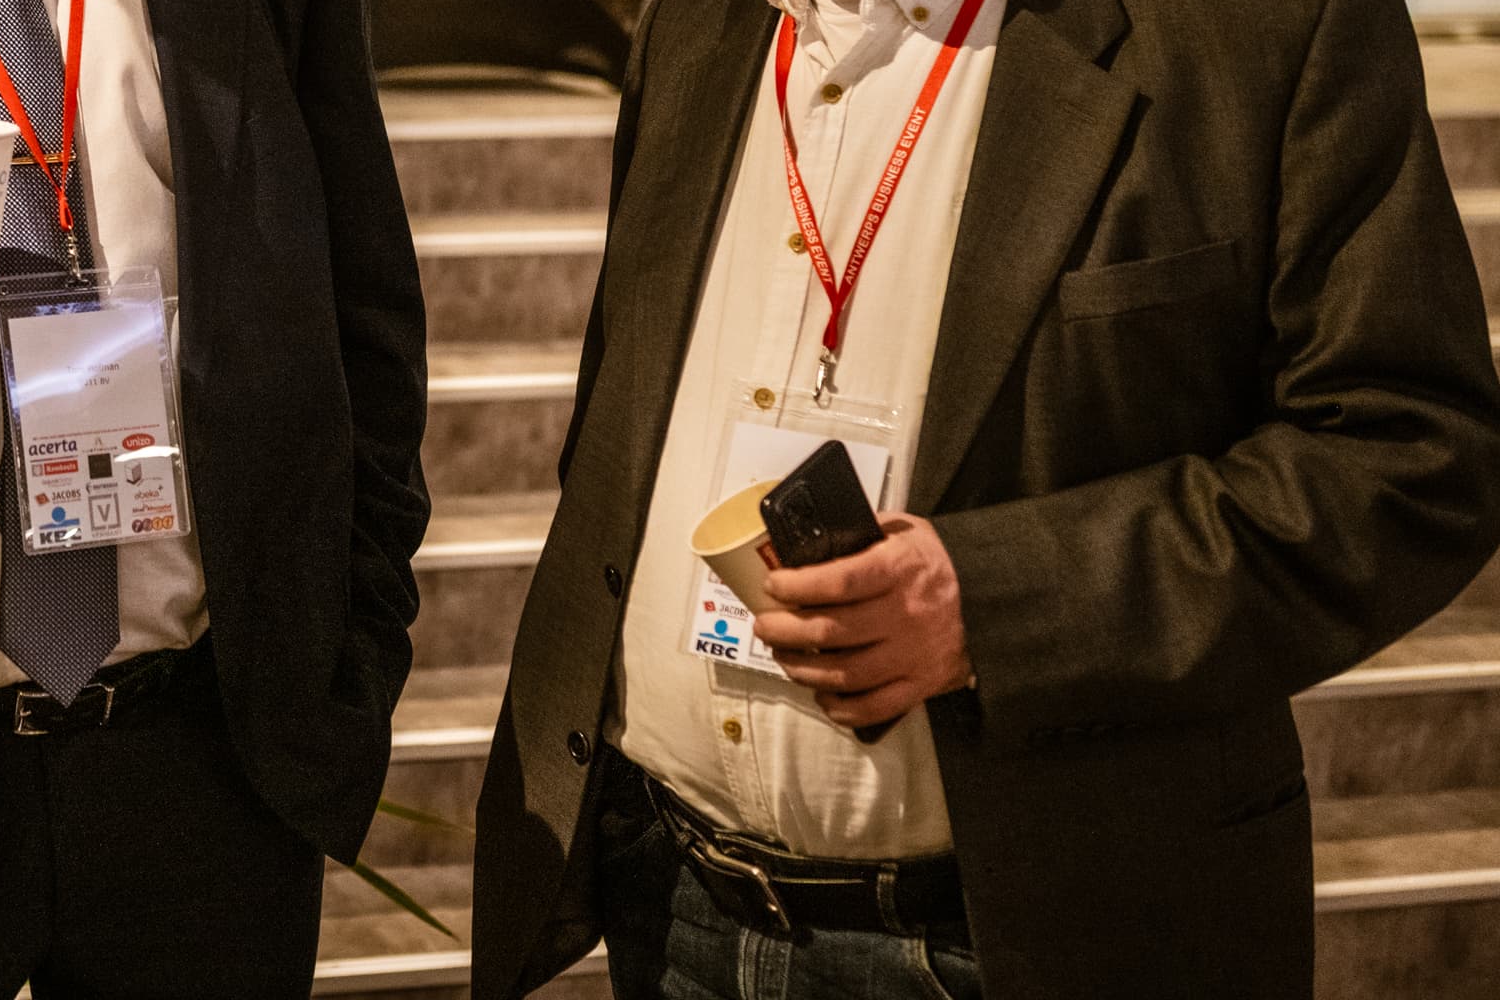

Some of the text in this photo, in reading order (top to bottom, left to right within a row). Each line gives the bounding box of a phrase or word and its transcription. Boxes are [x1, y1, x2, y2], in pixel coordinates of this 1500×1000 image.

[845, 106, 926, 285] ANTWERPS BUSINESS EVENT
[792, 186, 819, 244] BUSINESS
[811, 245, 833, 284] EVENT
[28, 439, 78, 456] acerta
[125, 436, 152, 447] unizo
[52, 488, 81, 500] JACOBS
[720, 603, 749, 617] JACOBS
[696, 639, 738, 660] KBC
